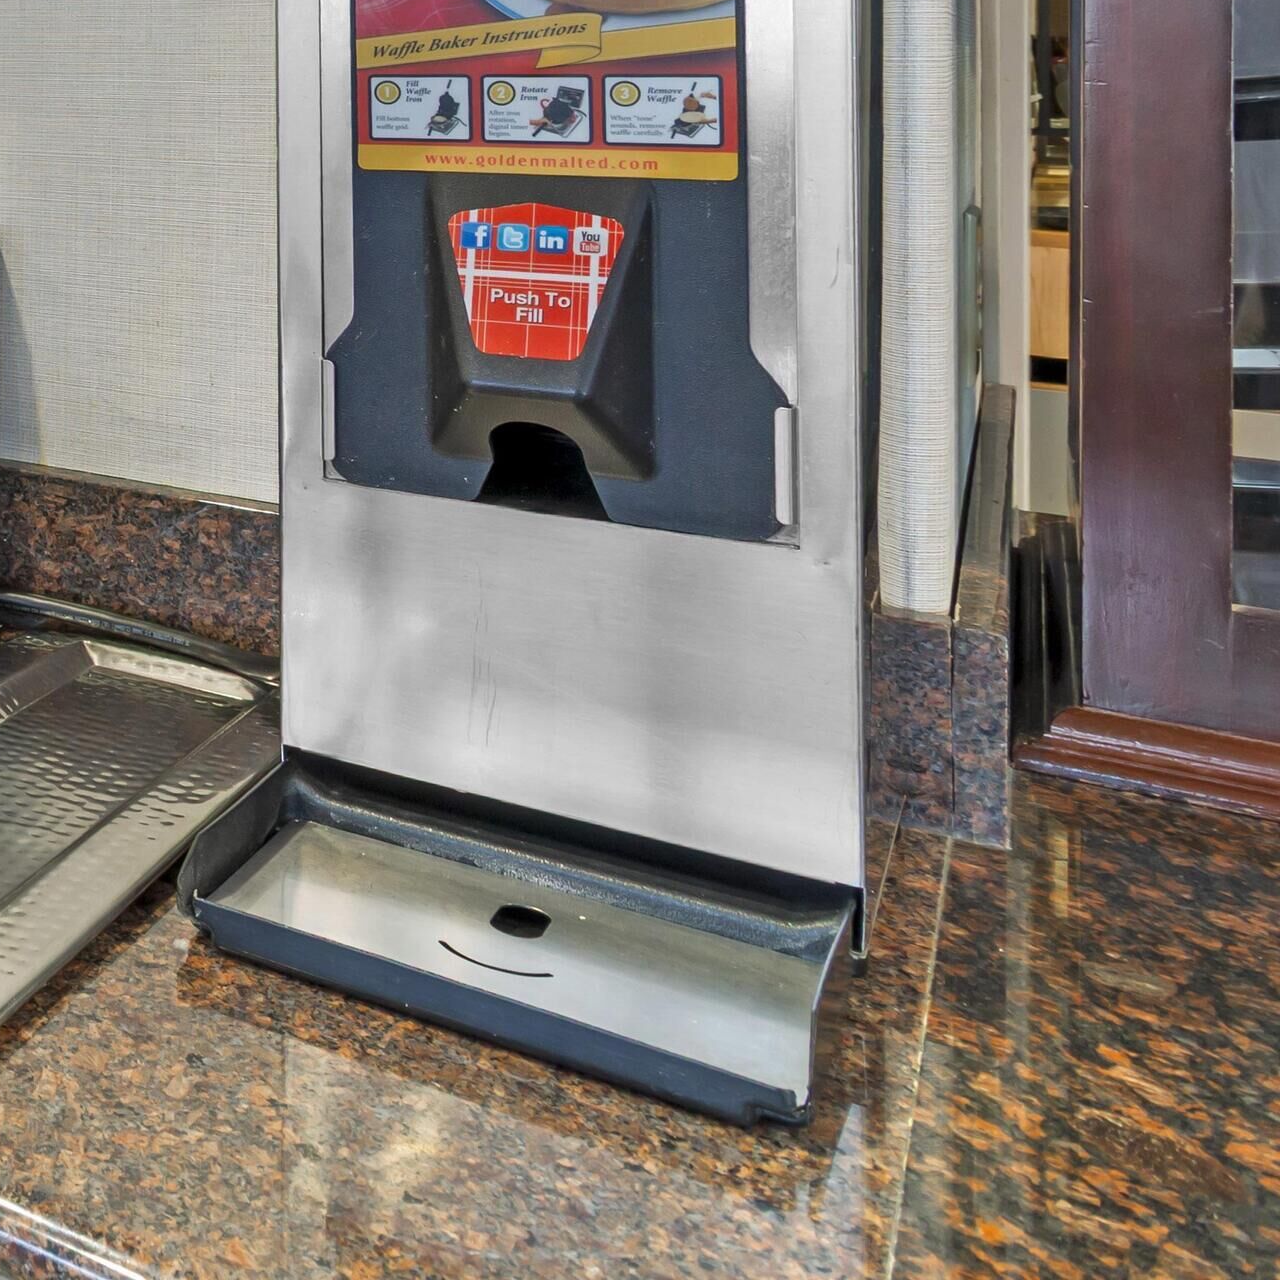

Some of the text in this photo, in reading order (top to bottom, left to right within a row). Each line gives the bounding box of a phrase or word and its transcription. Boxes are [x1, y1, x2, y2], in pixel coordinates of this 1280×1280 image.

[372, 21, 588, 59] Waffle Baker Instructions
[406, 80, 419, 88] Fill
[521, 86, 549, 94] Rotate
[406, 87, 432, 96] Waffle
[497, 87, 506, 99] 2
[621, 87, 630, 99] 3
[647, 87, 683, 95] Remove
[520, 94, 539, 102] Iron
[647, 95, 677, 103] Waffle
[425, 152, 659, 171] www.goldenmalted.com
[539, 230, 564, 249] in
[581, 231, 601, 242] You
[580, 242, 601, 254] Tube
[490, 288, 572, 309] Push To
[515, 307, 544, 324] Fill
